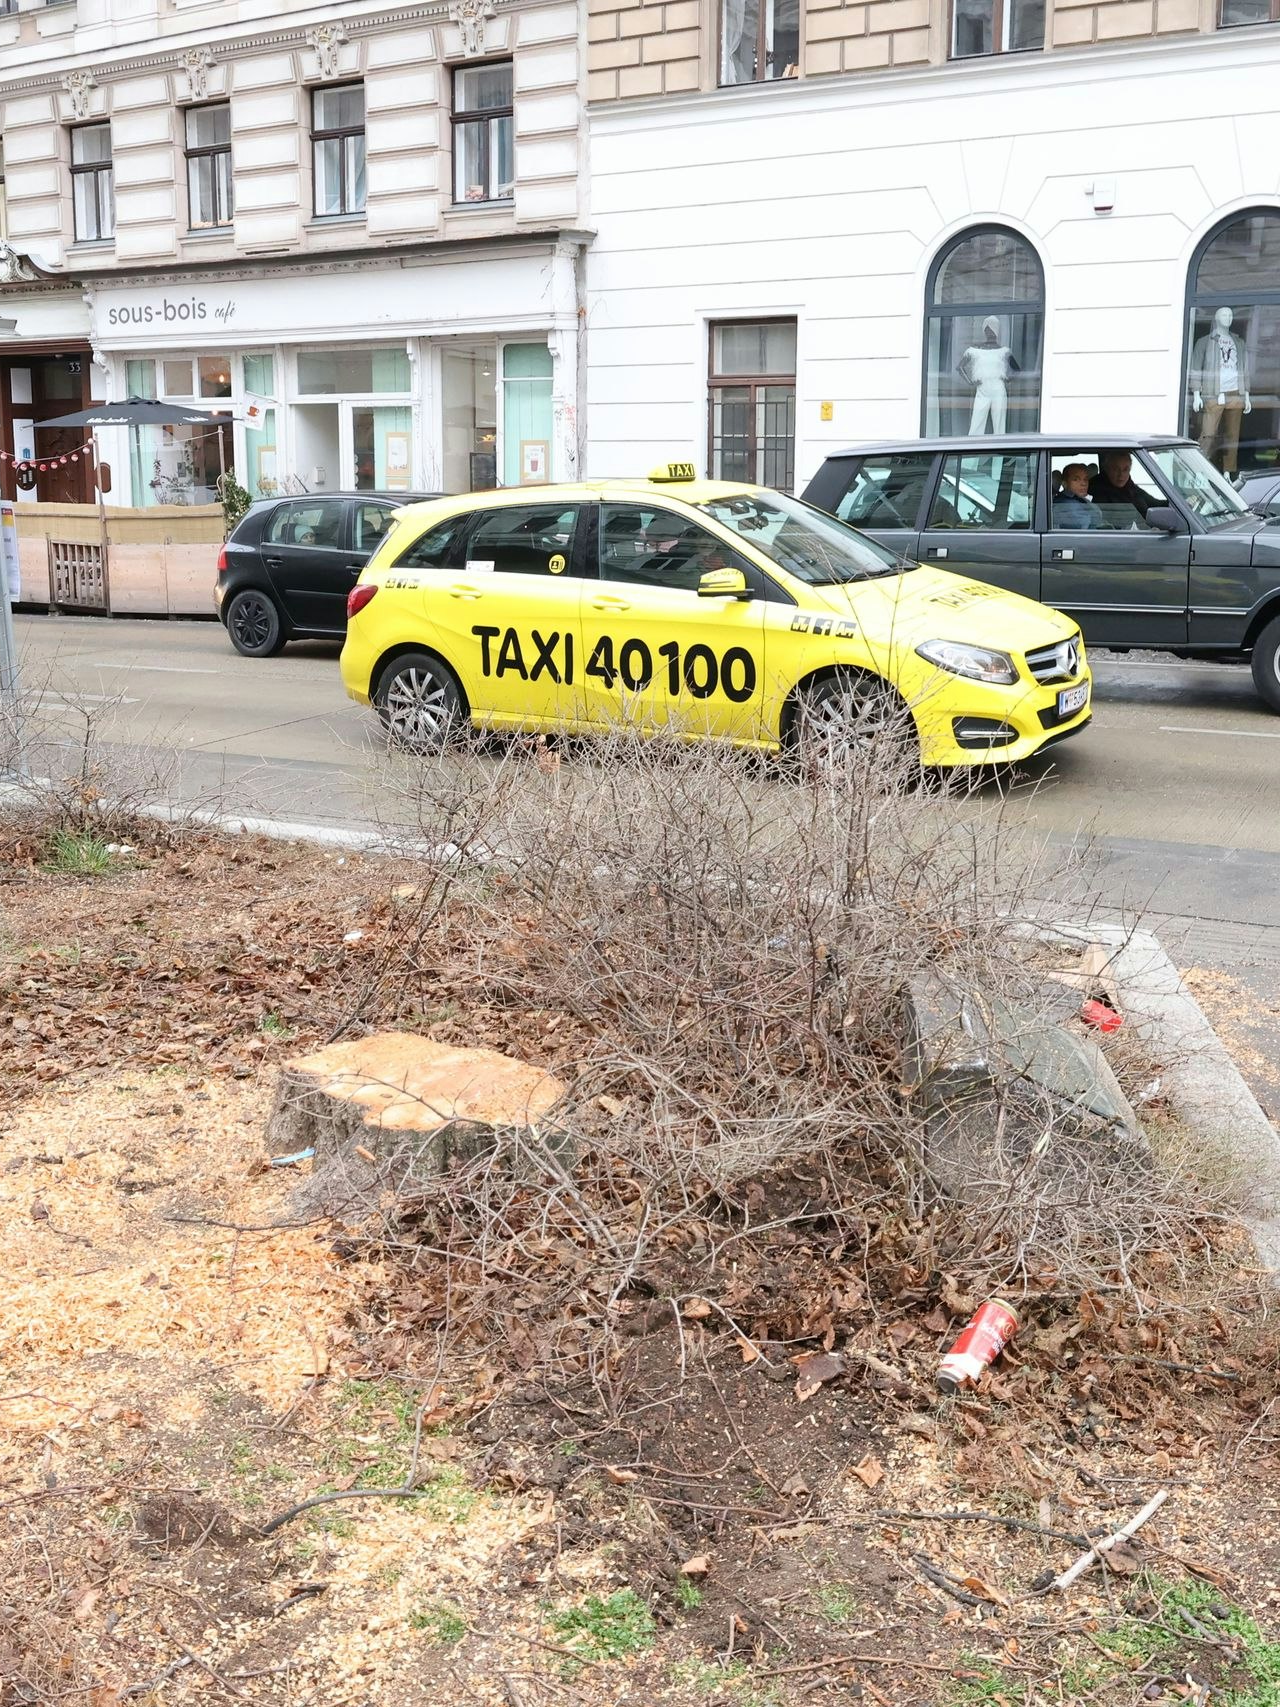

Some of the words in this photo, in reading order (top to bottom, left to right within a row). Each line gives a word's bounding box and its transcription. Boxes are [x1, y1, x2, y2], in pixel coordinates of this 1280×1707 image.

[108, 297, 207, 325] sous-bois
[214, 300, 237, 324] café
[69, 362, 81, 372] 33
[669, 464, 694, 477] TAXI
[471, 625, 574, 686] TAXI
